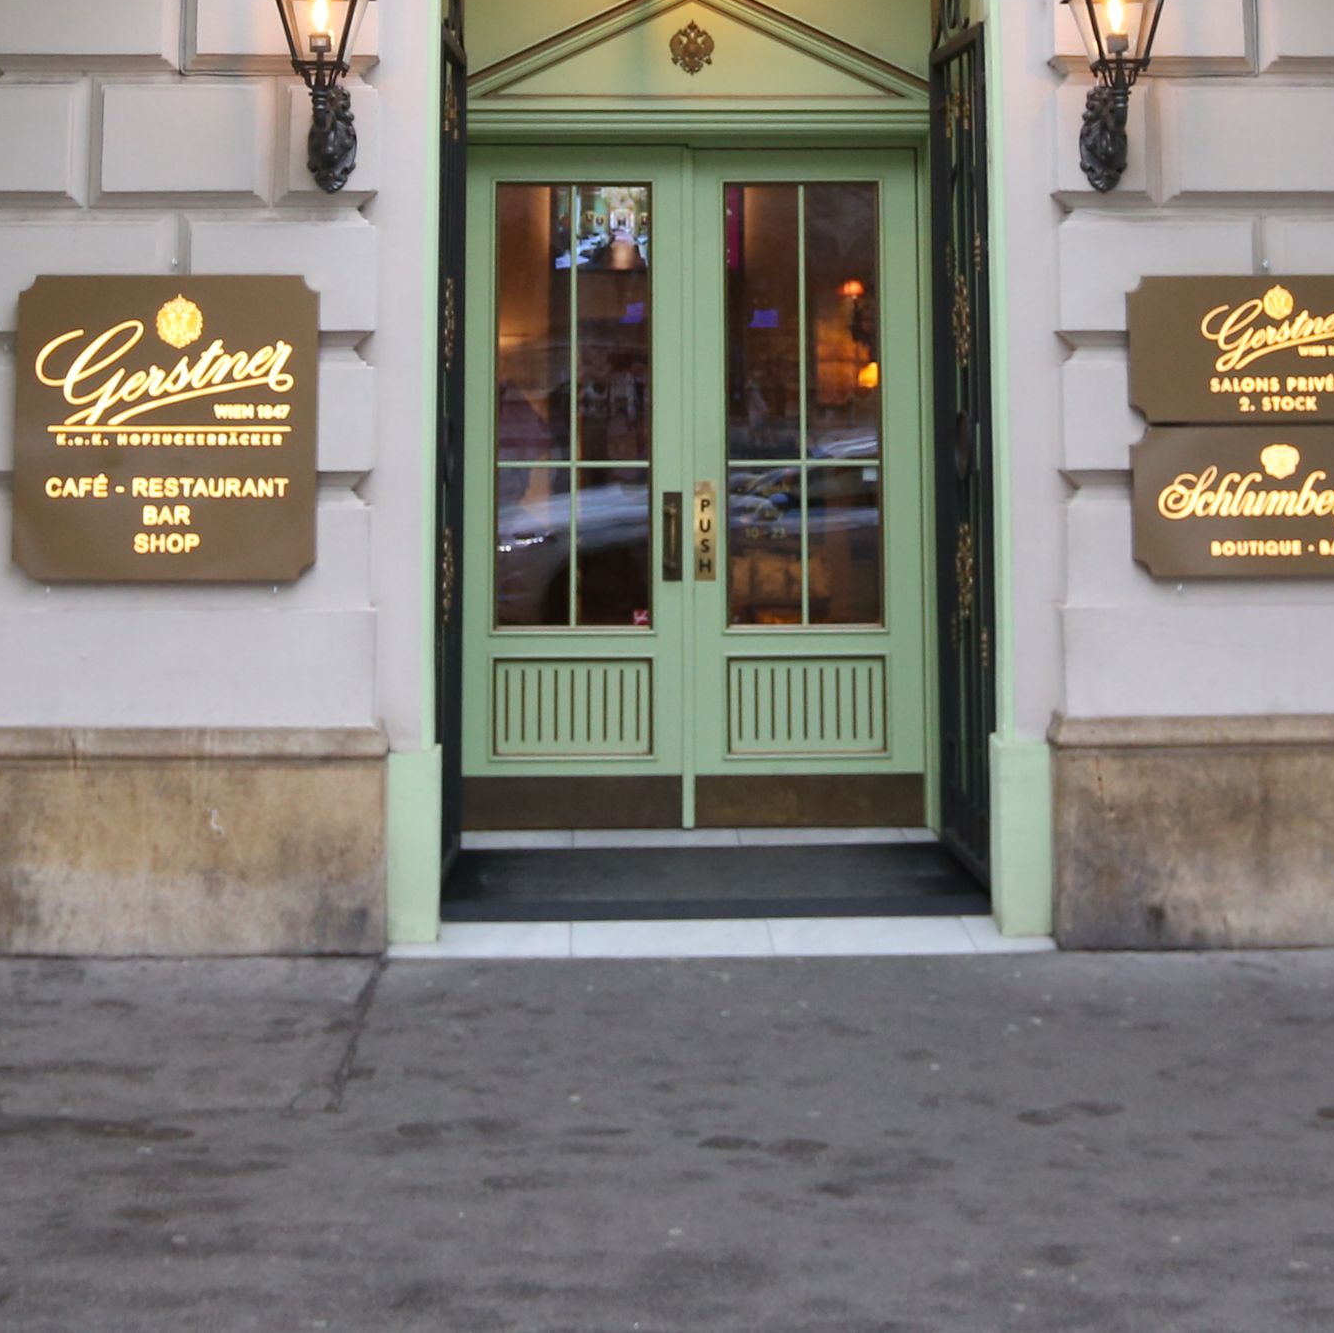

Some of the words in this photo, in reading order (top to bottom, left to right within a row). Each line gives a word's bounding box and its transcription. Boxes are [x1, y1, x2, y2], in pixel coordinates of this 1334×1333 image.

[35, 319, 294, 426] Gerstner
[1210, 376, 1280, 393] SALONS
[213, 404, 255, 419] WIEN
[257, 404, 291, 419] 1847
[1238, 395, 1256, 412] 2.
[1261, 395, 1317, 412] STOCK
[116, 431, 283, 446] HOFZUCKERBÄCKER
[45, 473, 109, 498] CAFÉ
[132, 477, 290, 498] RESTAURANT
[142, 505, 191, 526] BAR
[133, 533, 200, 554] SHOP
[698, 498, 712, 573] PUSH
[1210, 539, 1302, 557] BOUTIQUE
